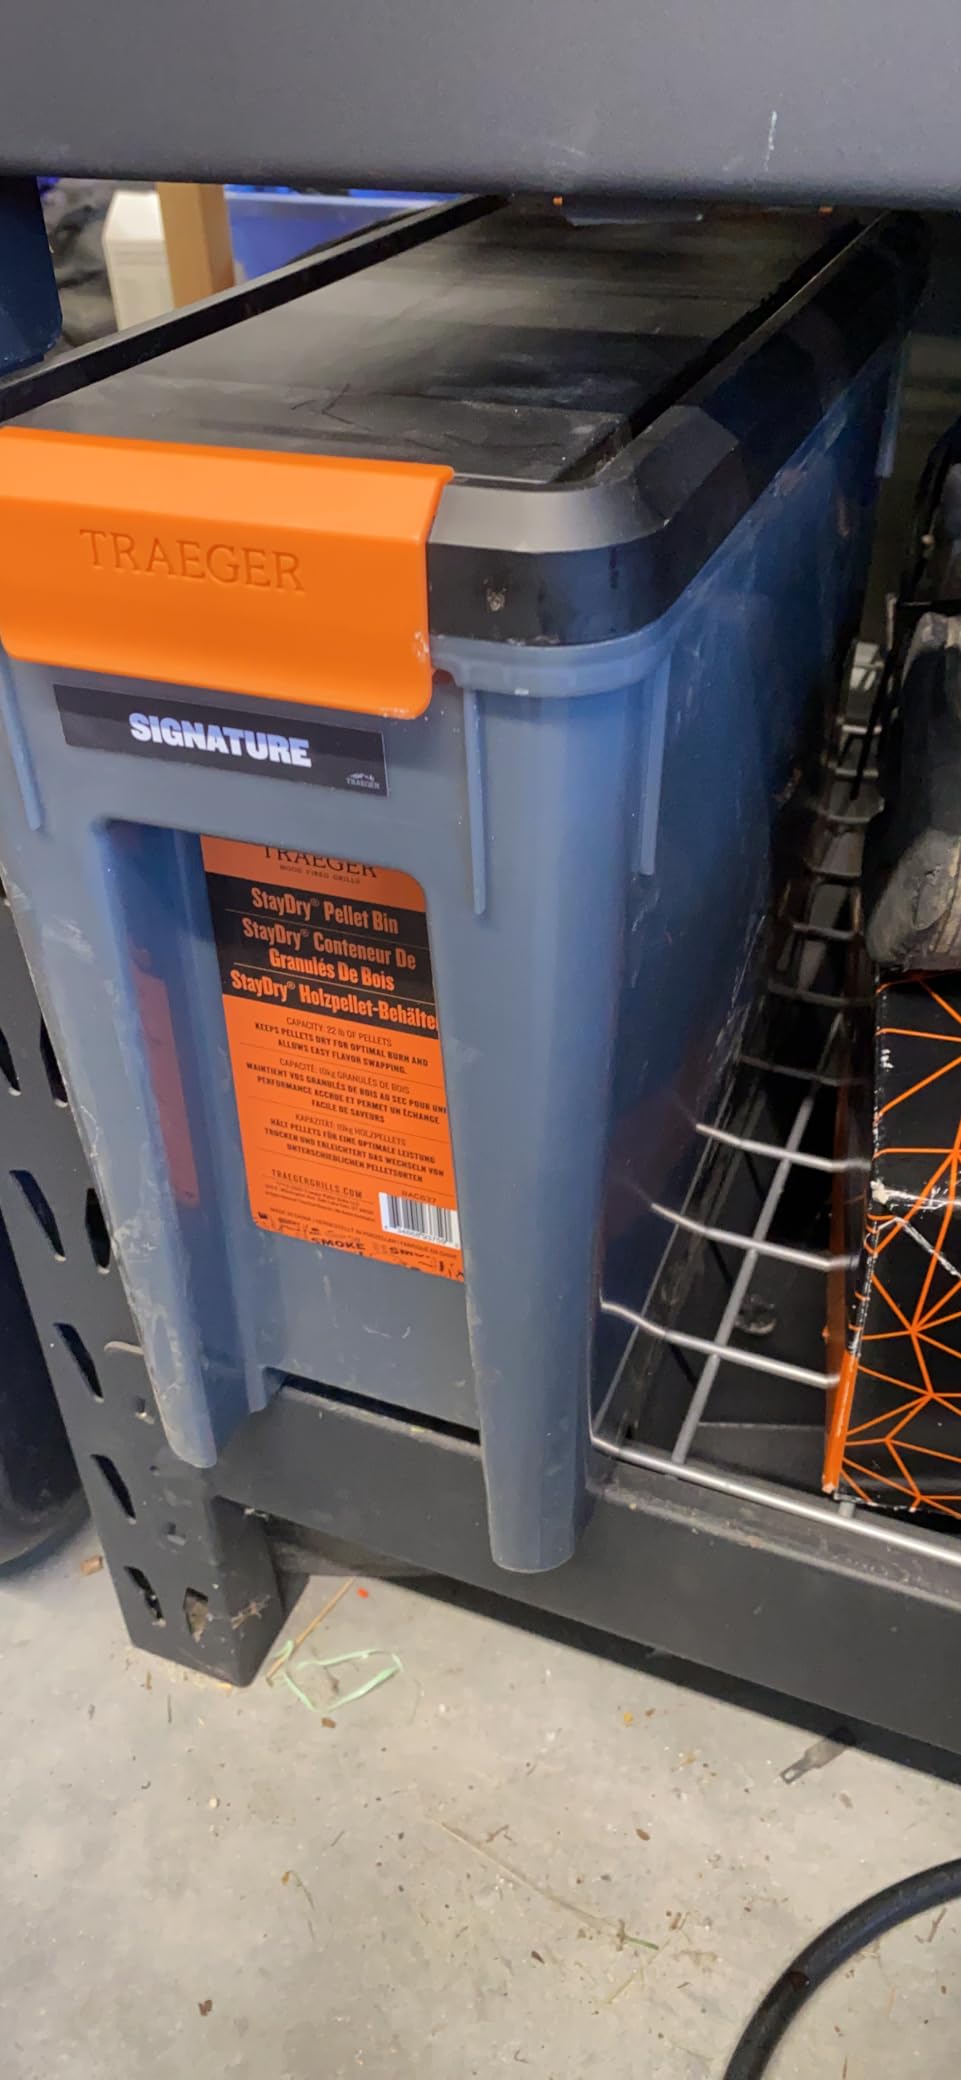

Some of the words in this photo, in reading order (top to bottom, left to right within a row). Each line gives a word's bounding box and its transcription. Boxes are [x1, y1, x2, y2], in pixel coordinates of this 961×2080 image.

[80, 528, 304, 592] TRAEGER
[129, 712, 311, 767] SIGNATURE
[323, 900, 369, 929] Pellet
[373, 911, 399, 934] Bin
[268, 948, 335, 979] Granulés
[338, 962, 359, 984] De
[361, 972, 395, 992] Bois
[313, 932, 391, 964] Conteneur
[395, 948, 416, 970] De
[254, 1022, 280, 1034] KEEPS
[281, 1028, 314, 1042] PELLETS
[315, 1034, 331, 1045] DRY
[333, 1039, 349, 1049] FOR
[350, 1042, 386, 1058] OPTIMAL
[387, 1051, 410, 1063] BURN
[411, 1056, 429, 1067] AND
[278, 1040, 309, 1052] ALLOWS
[310, 1046, 330, 1057] EASY
[332, 1050, 362, 1064] FLAVOR
[327, 1026, 337, 1035] 22
[347, 1030, 357, 1040] OF
[358, 1032, 393, 1048] PELLETS
[245, 1062, 288, 1078] MAINTIENT
[289, 1071, 305, 1082] VOS
[306, 1074, 347, 1092] GRANULÉS
[347, 1084, 358, 1094] DE
[360, 1087, 378, 1099] BOIS
[380, 1091, 391, 1101] AU
[392, 1094, 408, 1105] SEC
[409, 1098, 431, 1110] POUR
[257, 1076, 313, 1096] PERFORMANCE
[314, 1089, 344, 1102] ACCRUE
[345, 1095, 355, 1105] ET
[356, 1098, 388, 1112] PERMET
[390, 1106, 401, 1115] UN
[402, 1107, 440, 1125] ÉCHANGE
[337, 1070, 379, 1087] GRANULÉS
[380, 1080, 391, 1090] DE
[391, 1082, 411, 1094] BOIS
[311, 1099, 337, 1112] FACILE
[338, 1106, 349, 1115] DE
[350, 1108, 385, 1123] SAVEURS
[264, 1127, 298, 1142] TROCKEN
[300, 1136, 315, 1146] UND
[316, 1140, 367, 1158] ERLEICHTERT
[368, 1152, 384, 1163] DAS
[385, 1156, 427, 1173] WECHSELN
[428, 1166, 444, 1177] VON
[290, 1123, 322, 1137] PELLETS
[339, 1134, 356, 1145] EINE
[357, 1138, 396, 1155] OPTIMALE
[397, 1148, 436, 1164] LEISTUNG
[355, 1126, 407, 1146] HOLZPELLETS
[286, 1143, 365, 1169] UNTERSCHIEDLICHEN
[366, 1162, 423, 1183] PELLETSORTEN
[271, 1168, 363, 1199] TRAEGERGRILLS.COM
[311, 1237, 366, 1251] SMOKE
